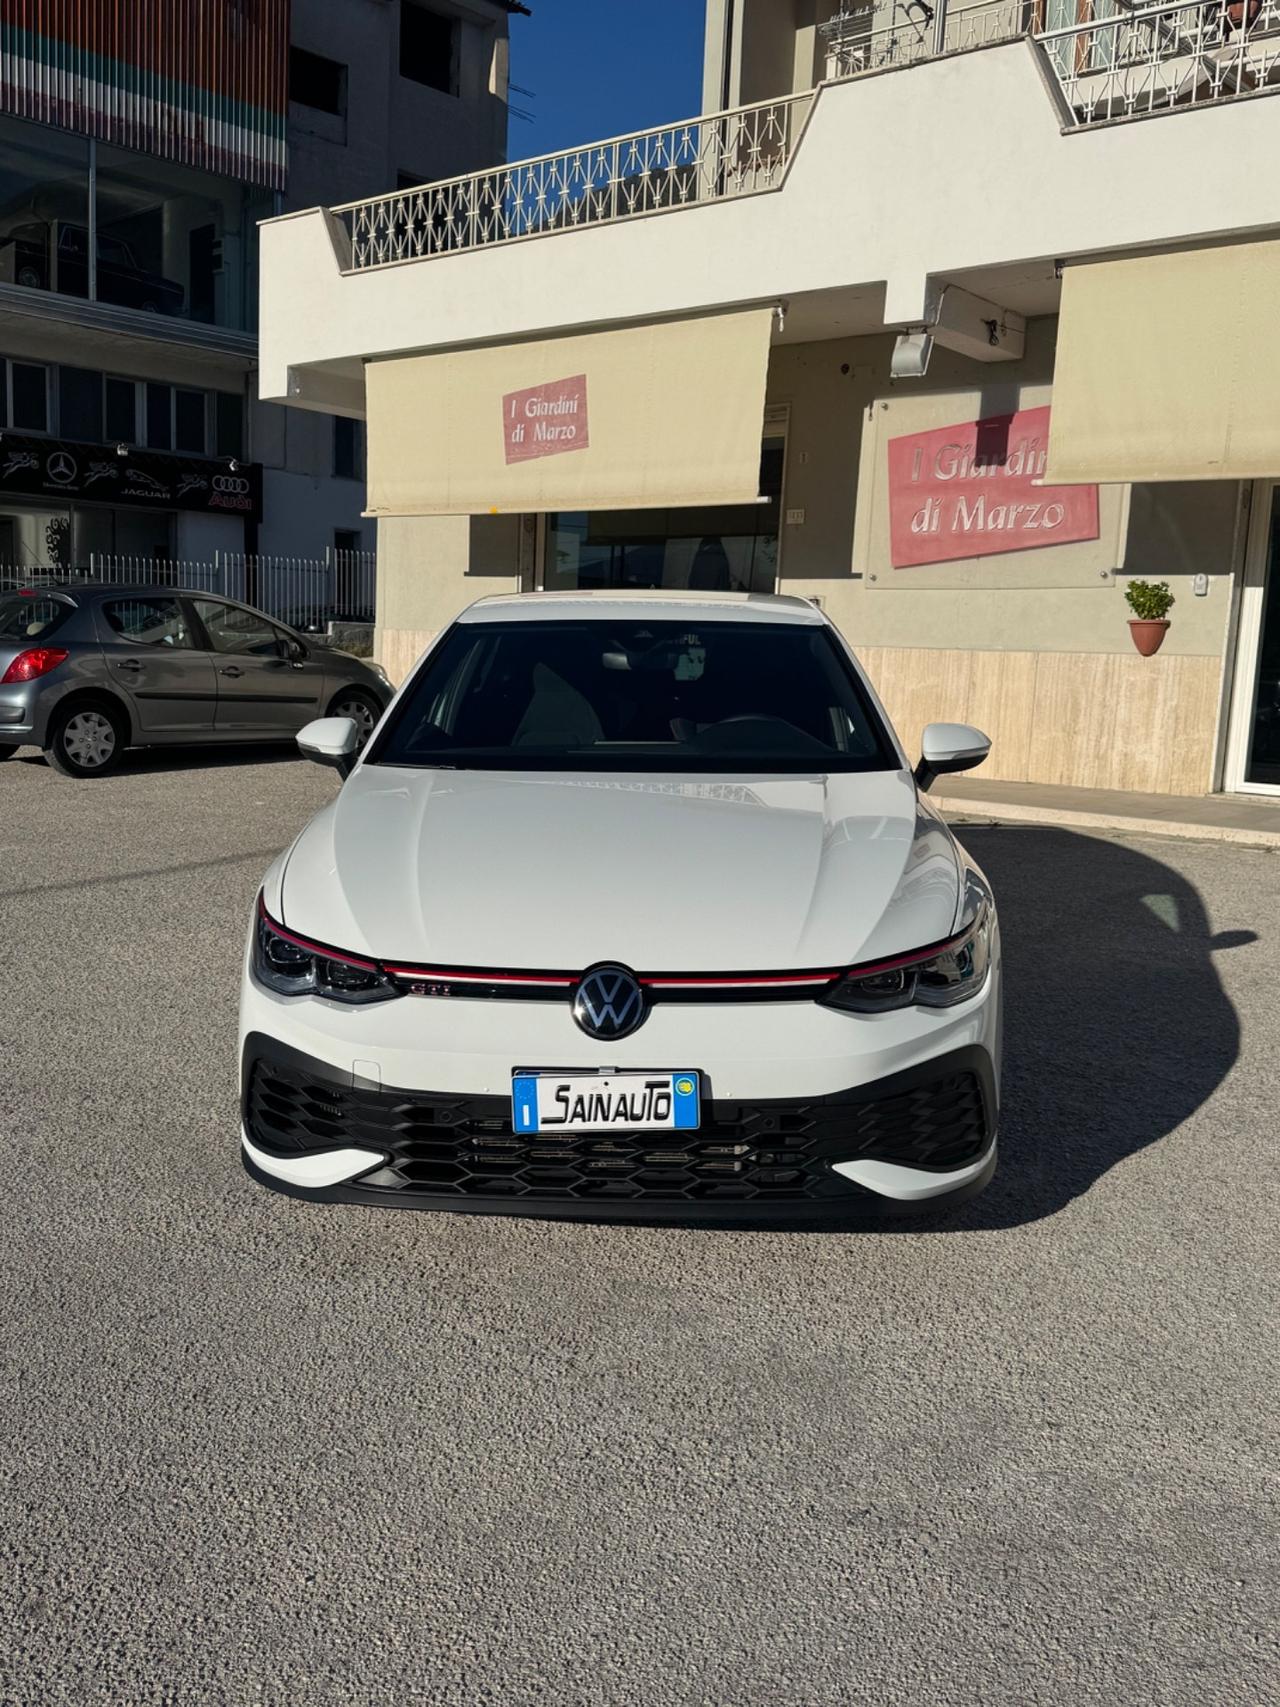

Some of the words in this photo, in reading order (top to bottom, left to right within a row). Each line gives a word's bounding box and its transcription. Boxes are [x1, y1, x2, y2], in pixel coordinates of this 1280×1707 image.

[511, 400, 516, 418] I
[525, 394, 579, 418] Giardini
[512, 424, 525, 443] di
[533, 422, 577, 442] Marzo
[911, 448, 922, 484] I
[120, 488, 171, 500] JAGUAR
[208, 492, 252, 511] Audi
[911, 496, 943, 534] di
[952, 493, 1066, 534] Marzo
[410, 983, 451, 996] GTI
[541, 1080, 671, 1125] SAINAUTO
